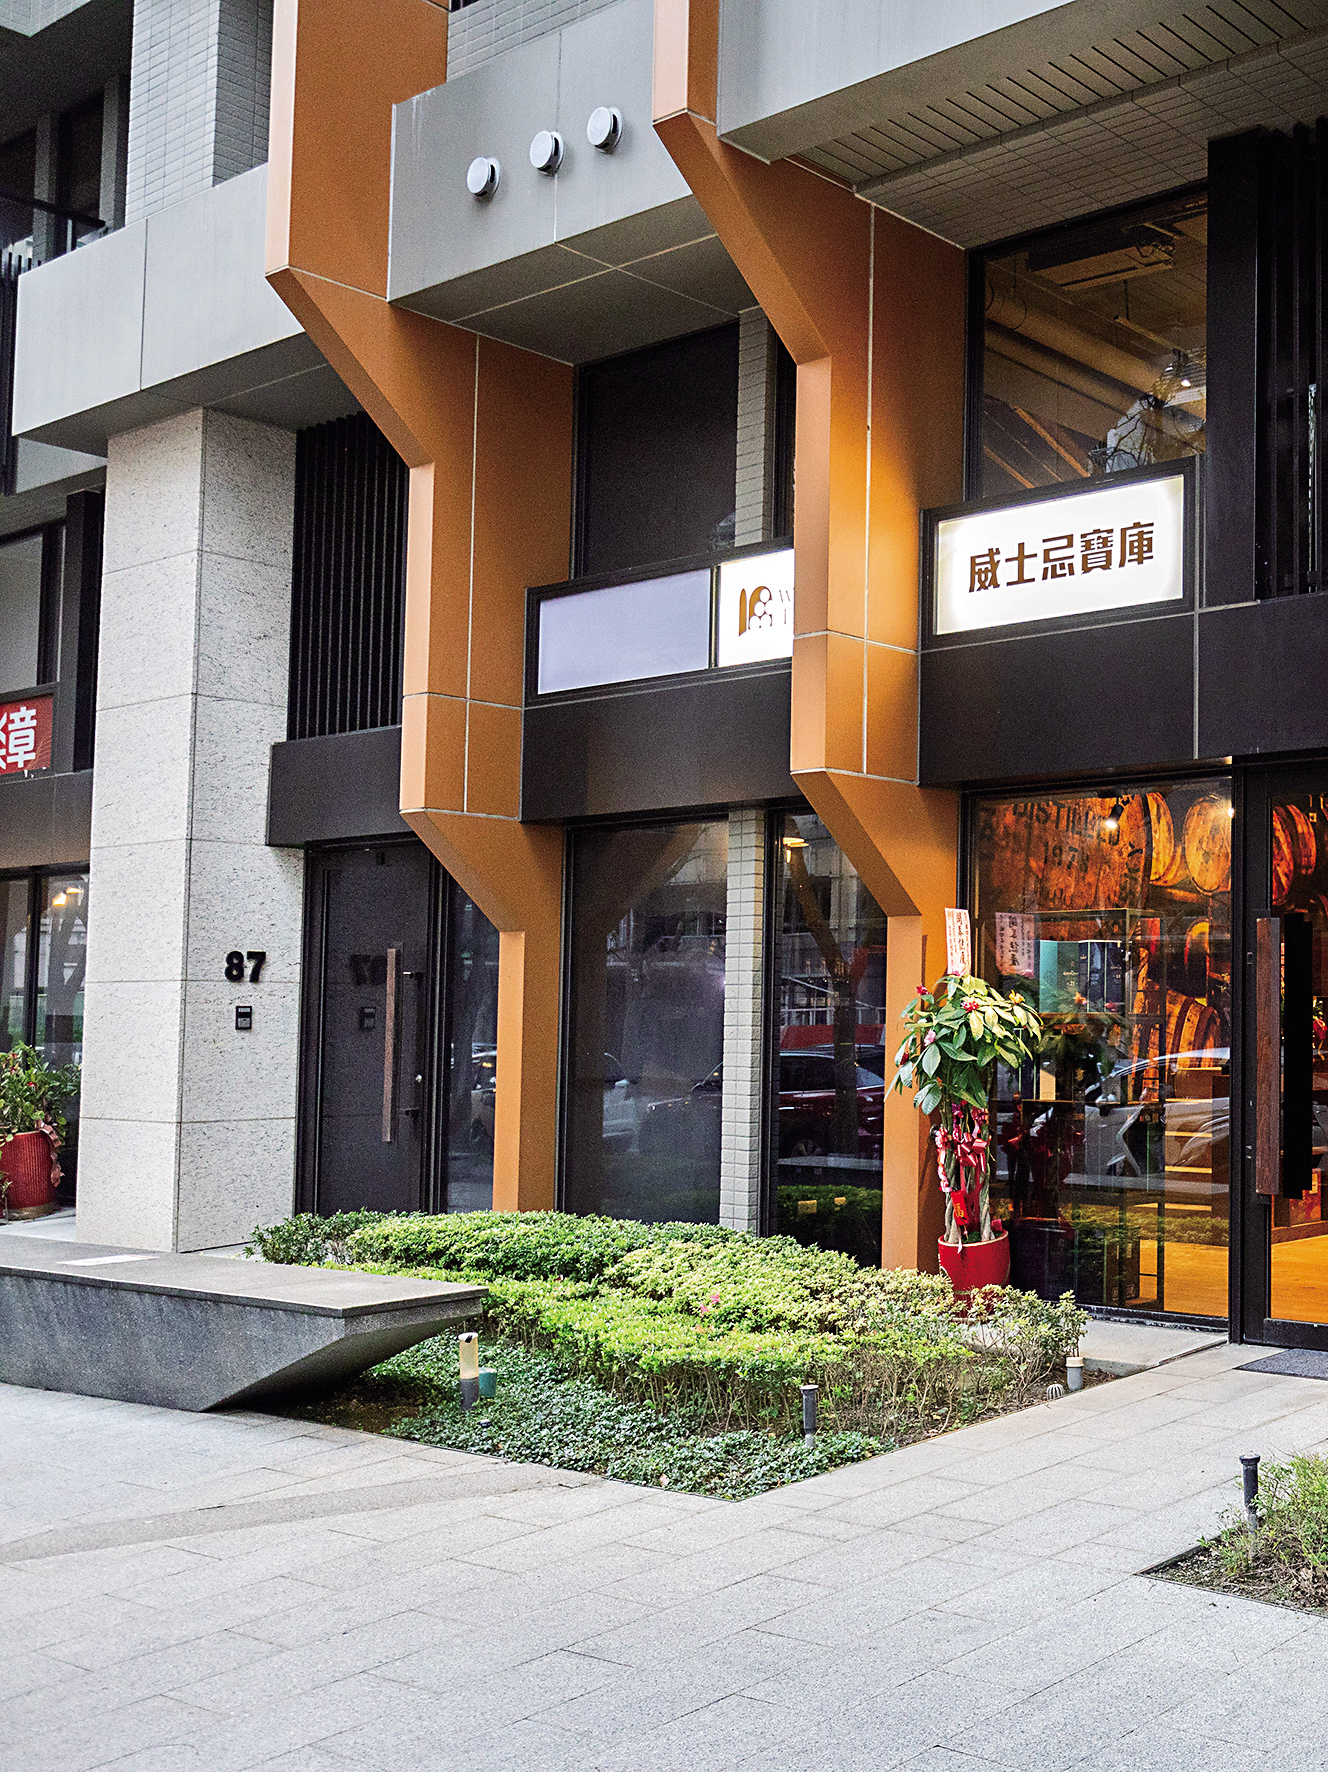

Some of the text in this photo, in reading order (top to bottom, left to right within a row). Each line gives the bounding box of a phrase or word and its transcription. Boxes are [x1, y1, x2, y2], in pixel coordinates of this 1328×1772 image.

[968, 521, 1155, 593] 威士忌寶庫
[224, 950, 267, 983] 87
